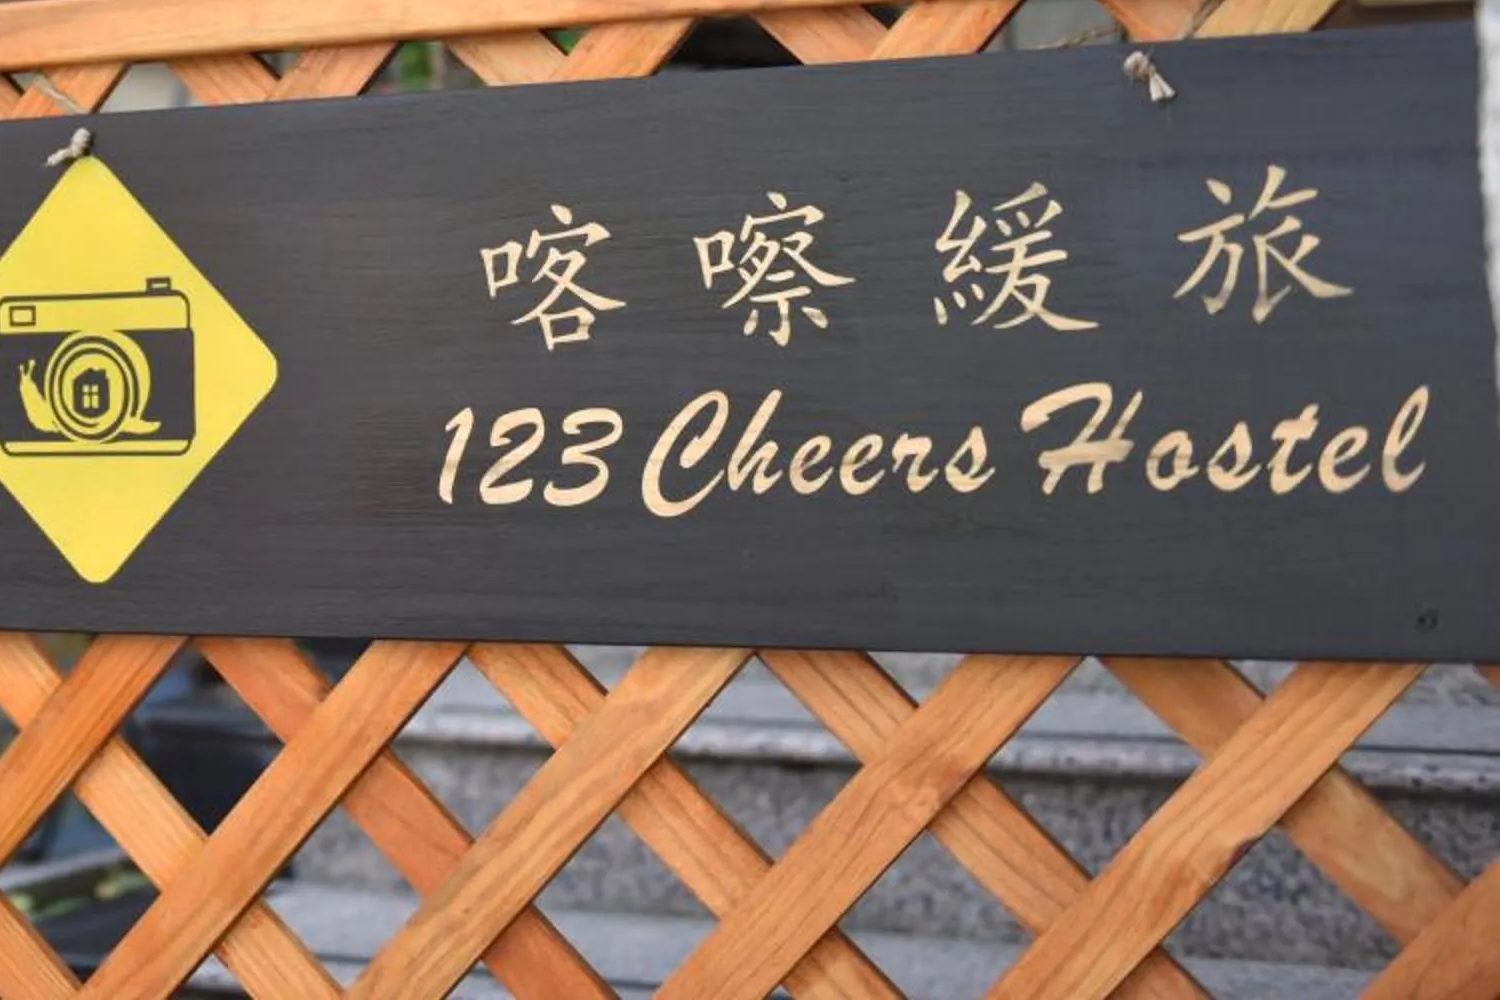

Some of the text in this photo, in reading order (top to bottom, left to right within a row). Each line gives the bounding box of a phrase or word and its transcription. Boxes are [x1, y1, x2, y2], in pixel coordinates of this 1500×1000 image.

[479, 164, 1353, 352] 喀嚓緩旅
[438, 381, 1430, 519] 123 Cheers Hostel
